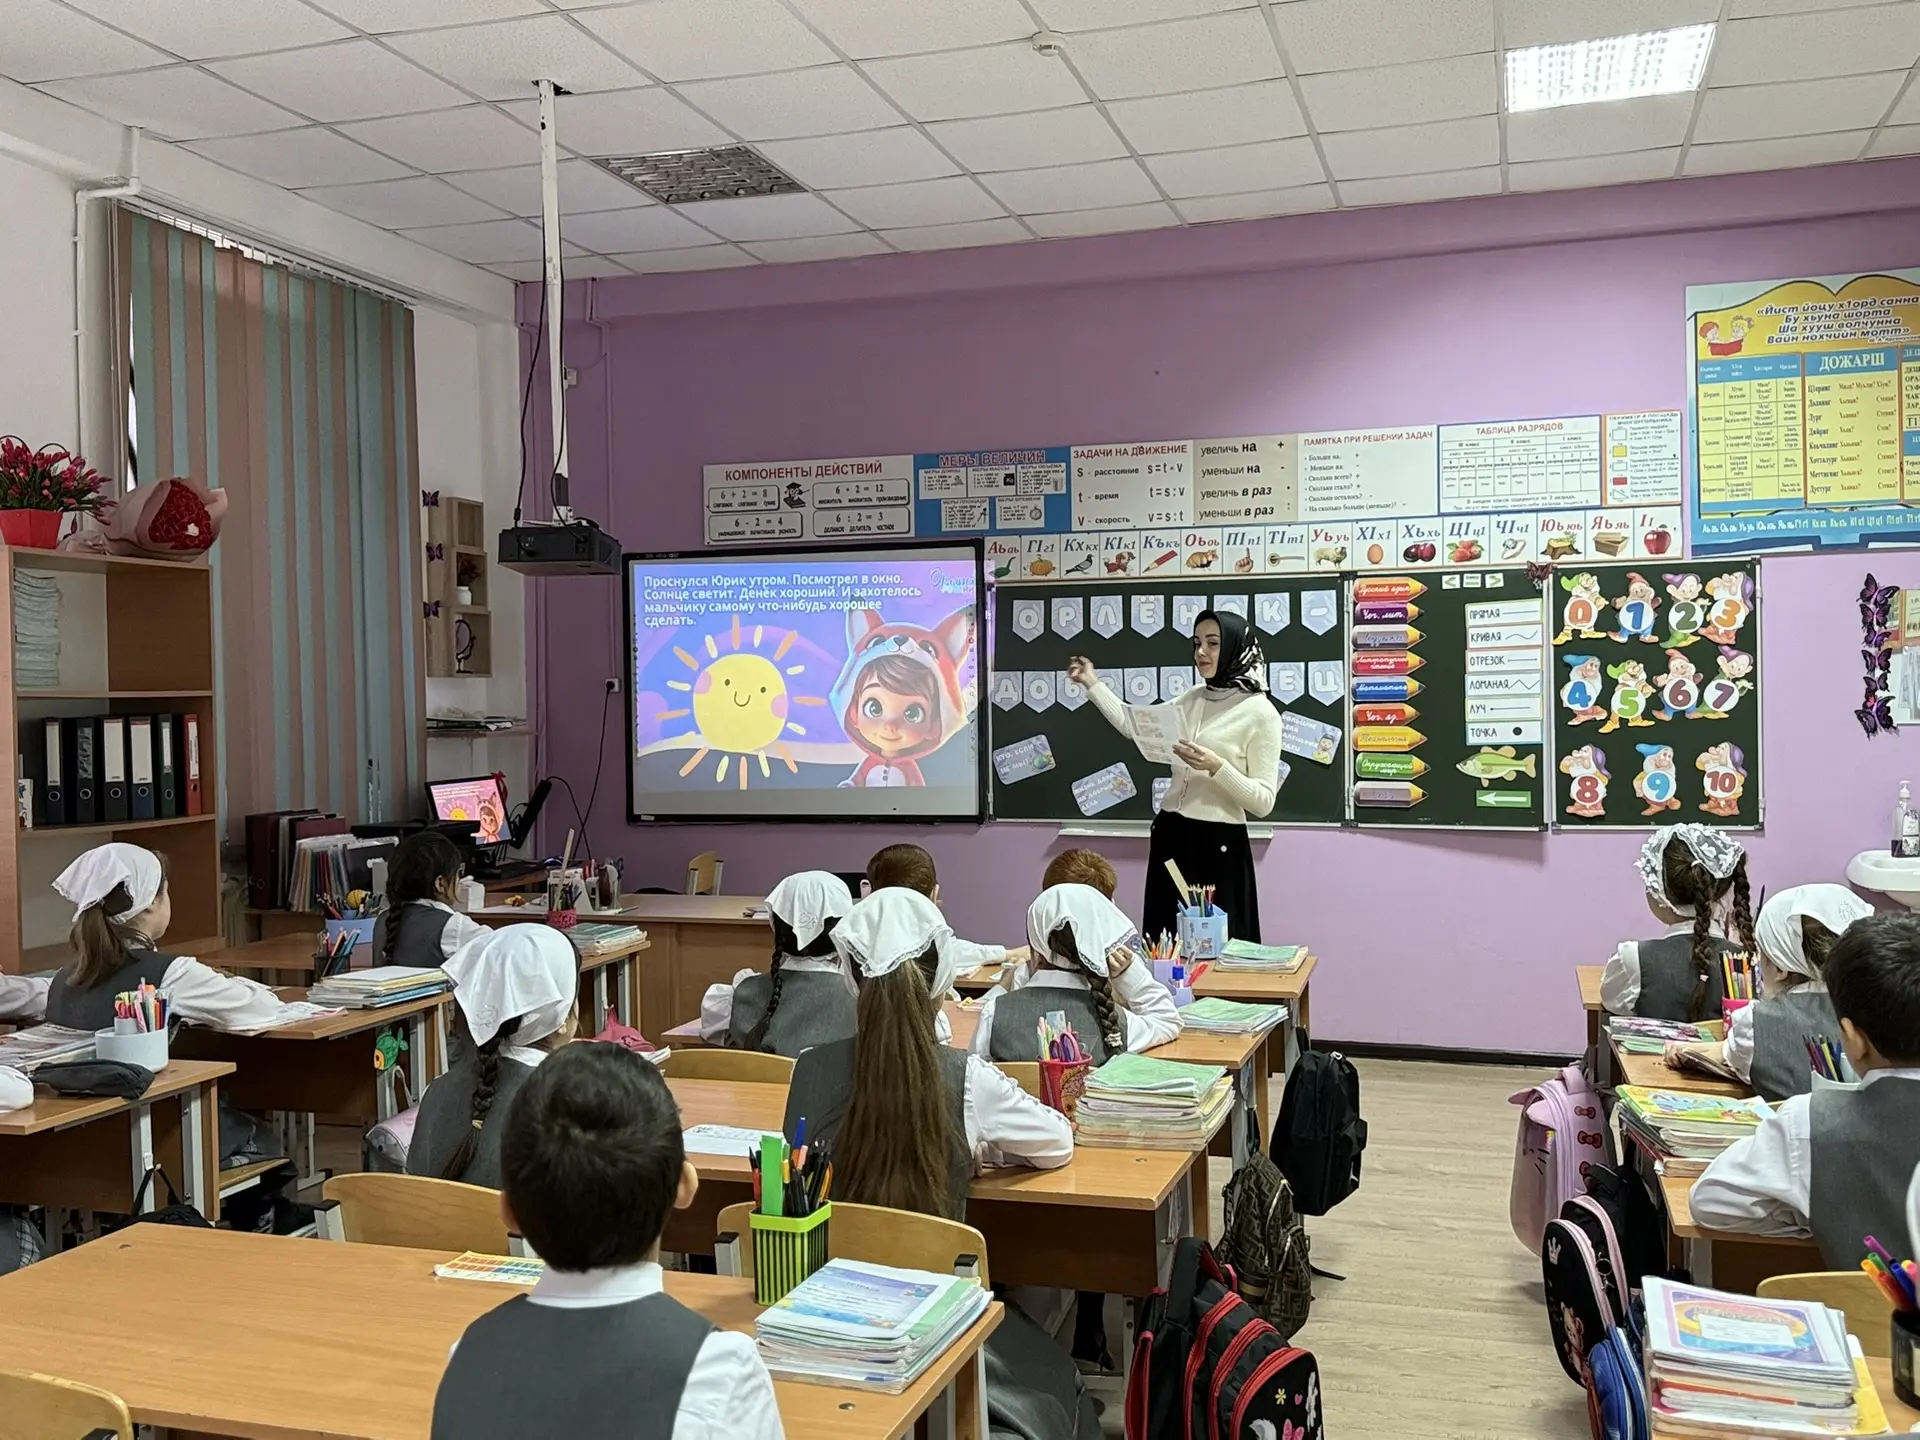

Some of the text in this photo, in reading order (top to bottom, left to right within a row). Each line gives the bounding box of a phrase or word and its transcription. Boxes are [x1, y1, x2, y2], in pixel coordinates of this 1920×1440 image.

[1802, 303, 1834, 313] йоцу
[1880, 296, 1919, 306] санна
[1786, 309, 1890, 324] Бу хьуна шорта
[1778, 325, 1797, 334] Ша
[1802, 323, 1834, 334] хууш
[1768, 334, 1798, 344] Вайн
[1802, 331, 1857, 341] нохчийн
[1820, 353, 1884, 372] ДОЖАРШ
[1476, 423, 1564, 436] ТАБЛИЦА РАЗРЯДОВ
[1304, 431, 1433, 446] ПАМЯТКА ПРИ РЕШЕНИИ ЗАДАЧ
[1073, 444, 1188, 460] ЗАДАЧИ НА ДВИЖЕНИЕ
[1200, 442, 1257, 456] увеличь на
[940, 450, 1046, 467] МЕРЫ ВЕЛИЧИН
[726, 460, 882, 481] КОМПОНЕНТЫ ДЕЙСТВИЙ
[1094, 466, 1140, 476] расстояние
[1201, 464, 1261, 477] уменьши на
[876, 484, 884, 492] 12
[1200, 486, 1272, 499] увеличь в раз
[1078, 491, 1120, 503] t время
[1095, 516, 1130, 525] скорость
[1199, 506, 1274, 520] уменьши в раз
[644, 574, 904, 589] Проснулся Юрик утром. Посмотрел в окно.
[644, 586, 922, 602] Солнце светит. Денёк хороший. И захотелось
[644, 600, 882, 616] мальчику самому что-нибудь хорошее
[1470, 608, 1500, 620] ПРЯМАЯ
[1569, 600, 1592, 624] 0
[1714, 600, 1742, 628] 3
[644, 614, 697, 628] сделать.
[1626, 602, 1644, 630] 1
[1674, 602, 1698, 630] 2
[1470, 632, 1502, 642] КРИВАЯ
[1470, 656, 1506, 666] ОТРЕЗОК
[1470, 680, 1509, 690] ЛОМАНАЯ
[1567, 680, 1592, 708] 4
[1668, 680, 1692, 708] 6
[1712, 682, 1734, 710] 7
[1470, 704, 1486, 714] ЛУЧ
[1618, 689, 1640, 717] 5
[1470, 728, 1498, 738] ТОЧКА
[1014, 744, 1034, 756] ЕСЛИ
[1646, 774, 1670, 800] 9
[1706, 770, 1736, 793] 10
[1576, 775, 1600, 804] 8
